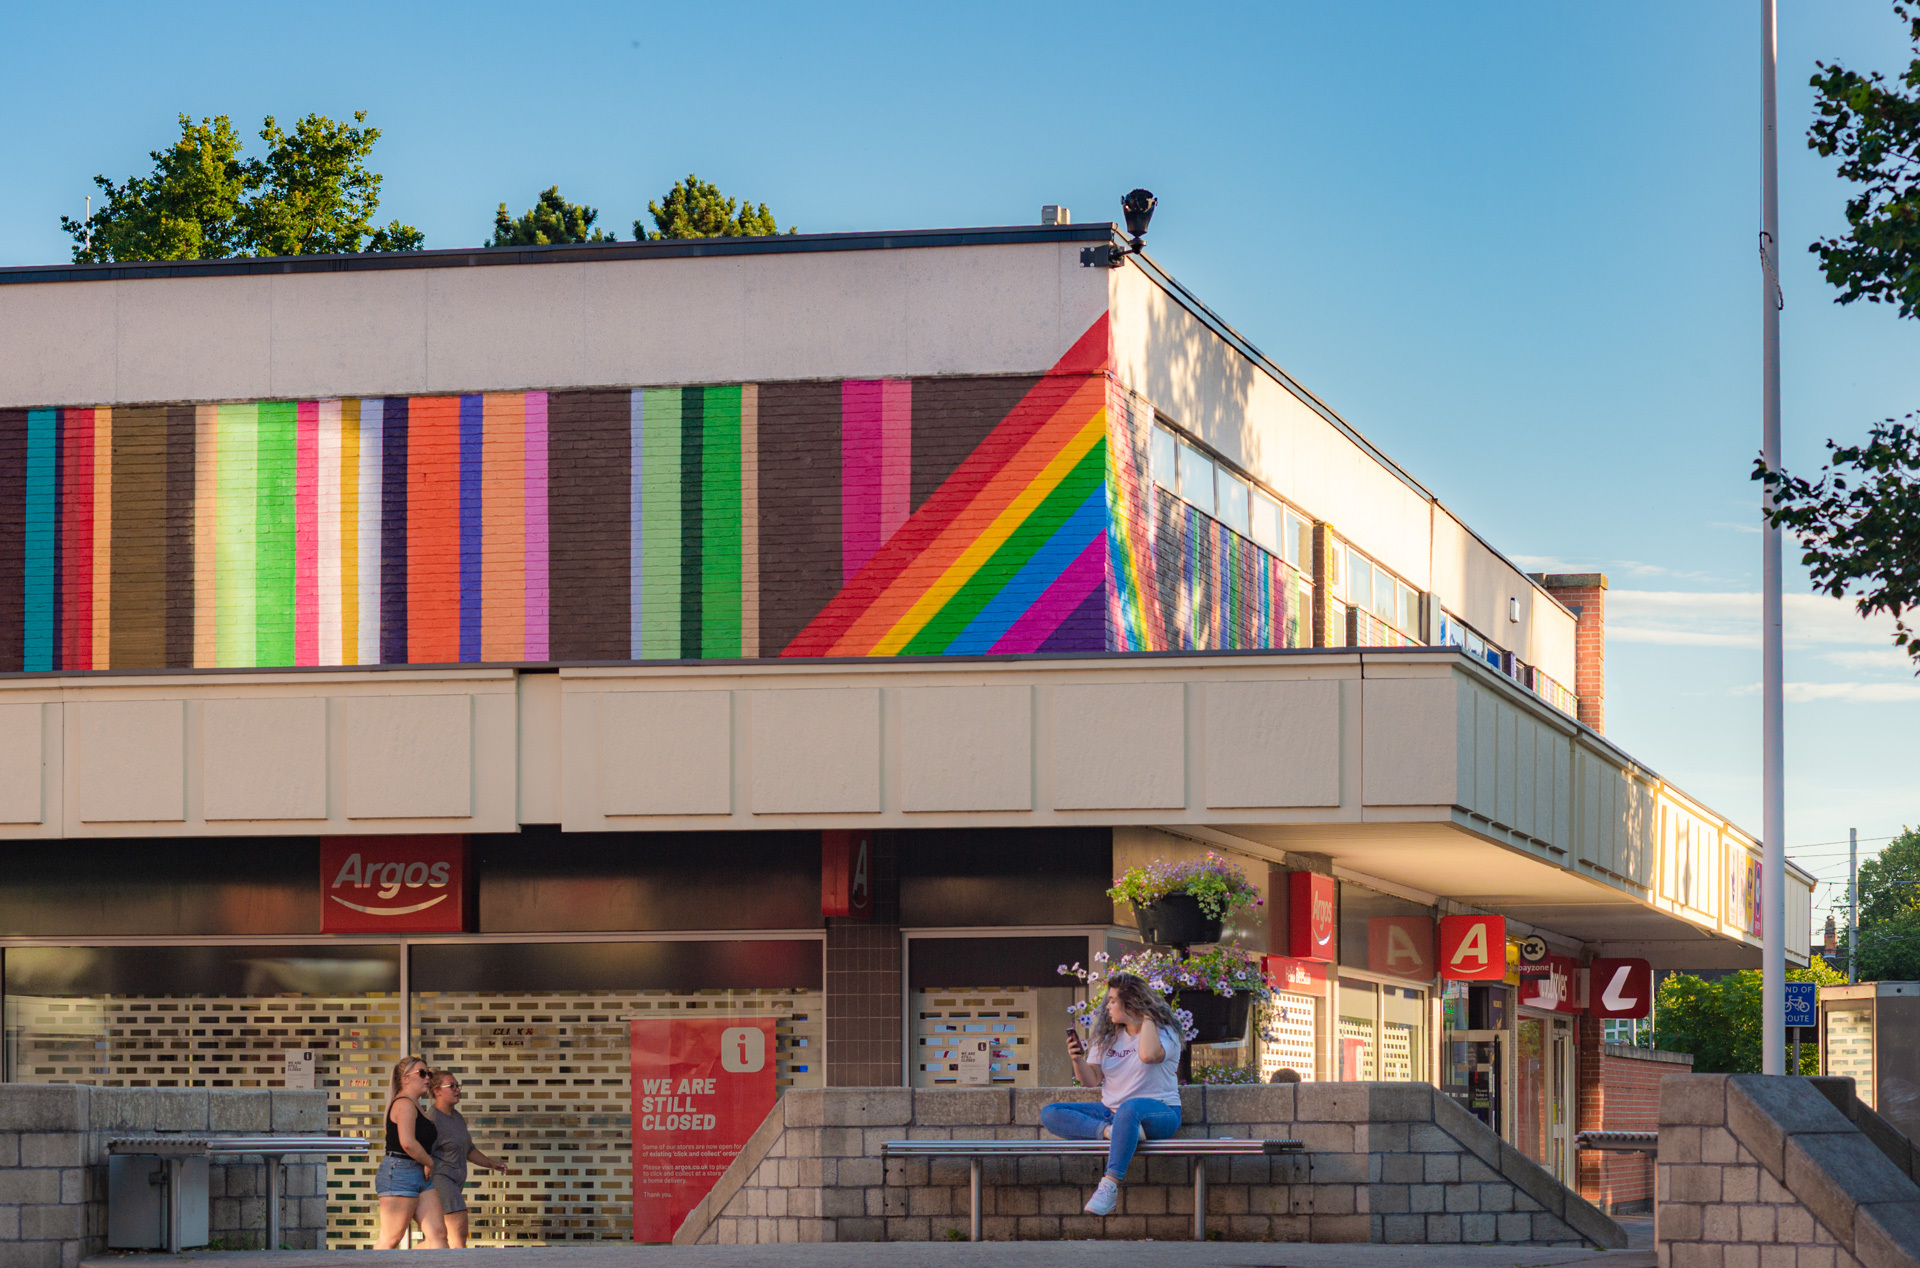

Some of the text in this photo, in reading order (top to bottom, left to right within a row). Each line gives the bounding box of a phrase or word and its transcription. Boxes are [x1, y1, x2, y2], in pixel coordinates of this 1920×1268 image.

[331, 853, 451, 899] Argos
[852, 840, 868, 896] A
[1312, 890, 1332, 931] Argos
[1450, 923, 1489, 964] A
[1601, 966, 1638, 1011] L
[642, 1078, 716, 1095] WE ARE
[642, 1096, 697, 1113] STILL
[642, 1114, 716, 1131] CLOSED
